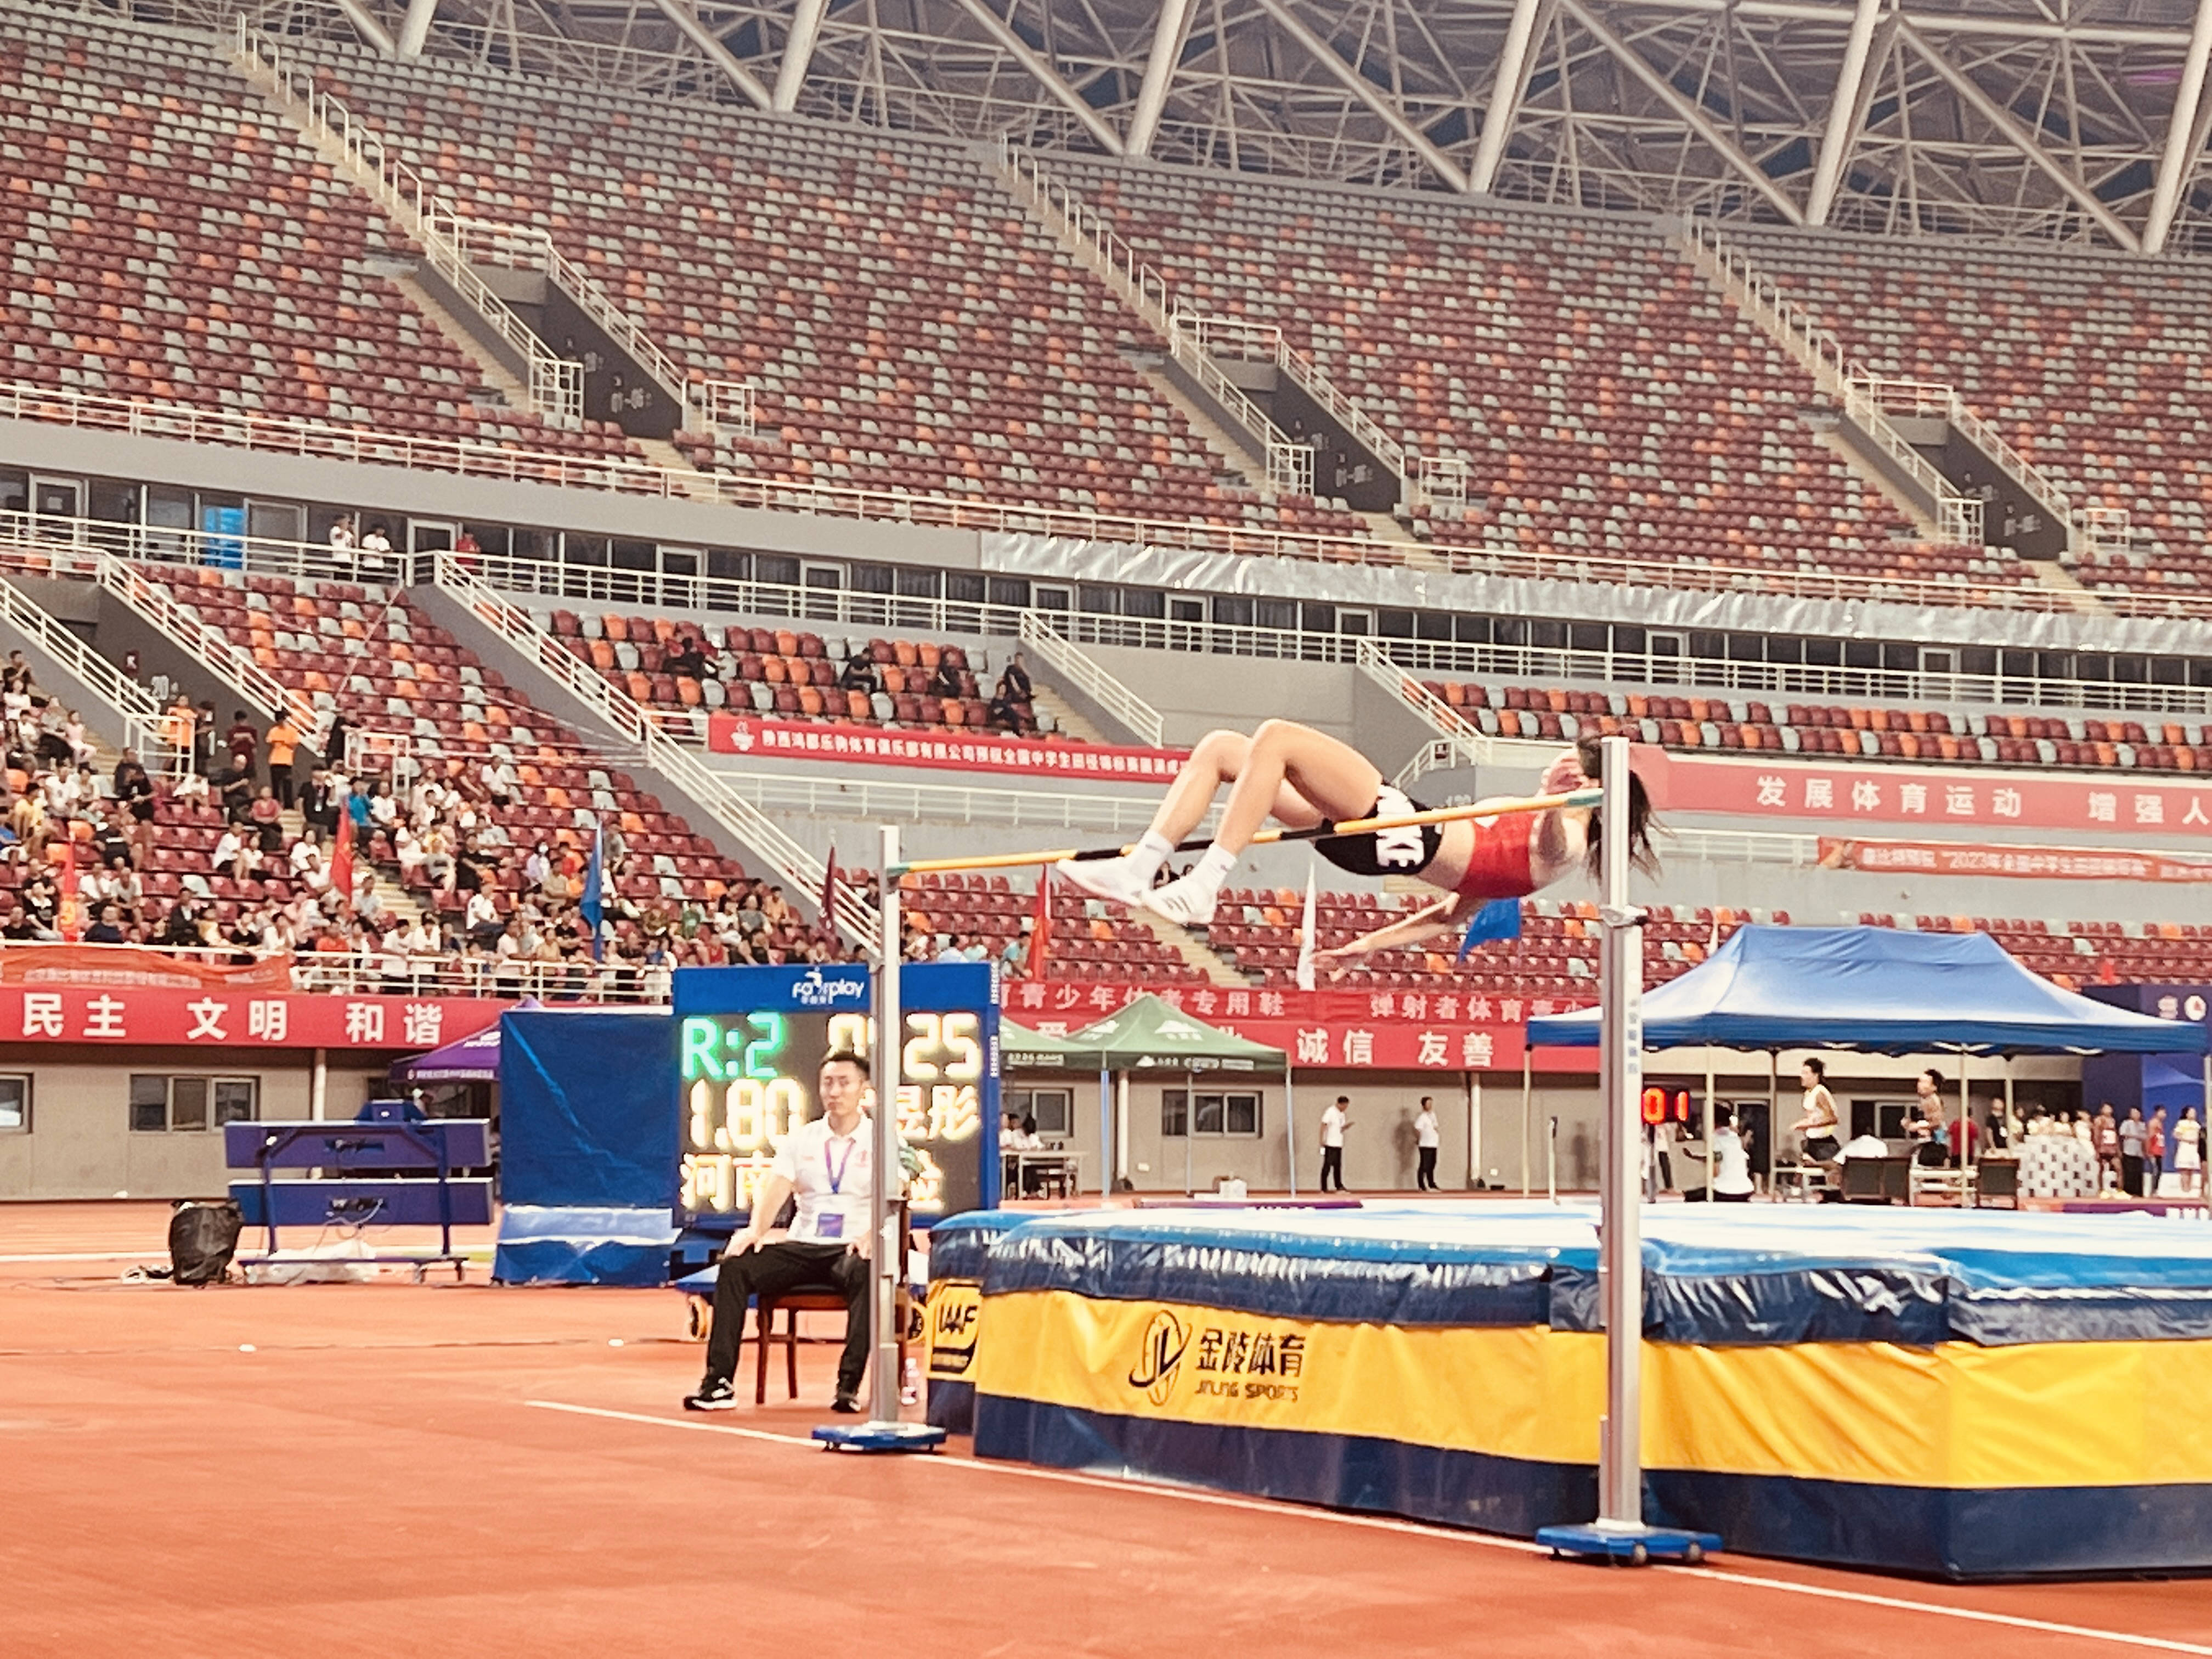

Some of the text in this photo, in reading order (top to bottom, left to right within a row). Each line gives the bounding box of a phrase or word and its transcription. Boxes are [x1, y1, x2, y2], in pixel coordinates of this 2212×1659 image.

[1756, 776, 2210, 825] 发展体育运动 增强人
[22, 992, 443, 1045] 民主 文明 和谐
[682, 1012, 783, 1078] R:2
[1297, 1028, 1375, 1065] 诚信
[1418, 1030, 1494, 1067] 友善
[690, 1077, 804, 1150] 1.80
[1195, 1328, 1306, 1378] 金陵体育
